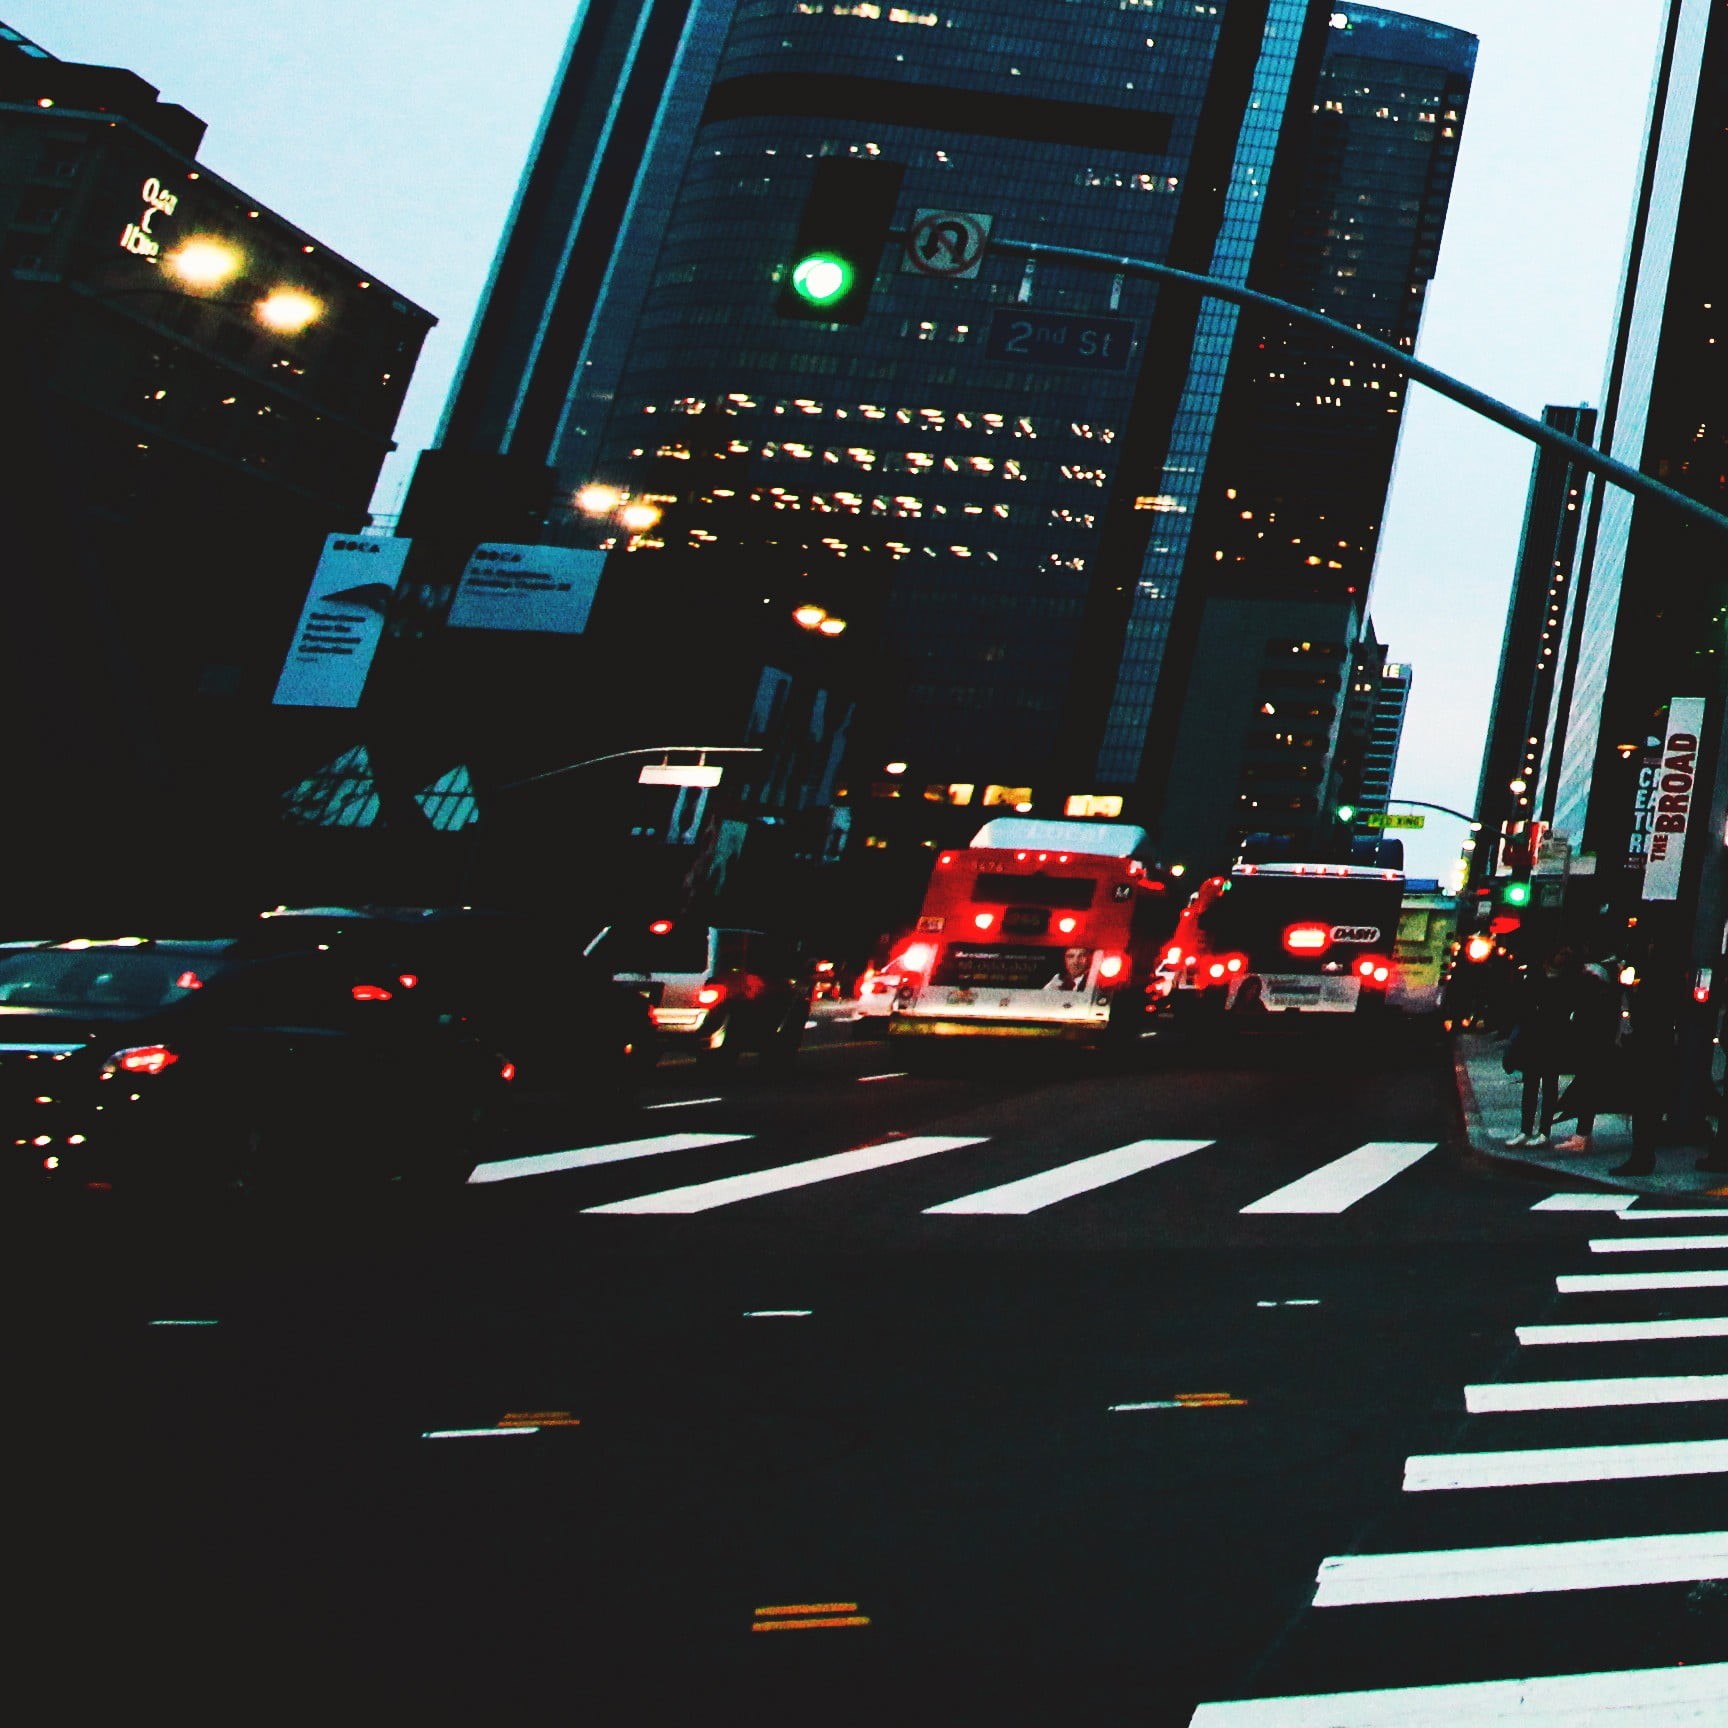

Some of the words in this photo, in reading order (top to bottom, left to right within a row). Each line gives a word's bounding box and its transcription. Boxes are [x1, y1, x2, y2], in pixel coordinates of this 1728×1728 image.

[1005, 320, 1066, 354] 2nd
[1079, 330, 1111, 357] St
[1655, 733, 1698, 833] BROAD
[1650, 833, 1669, 862] THE
[1333, 928, 1377, 941] DASH
